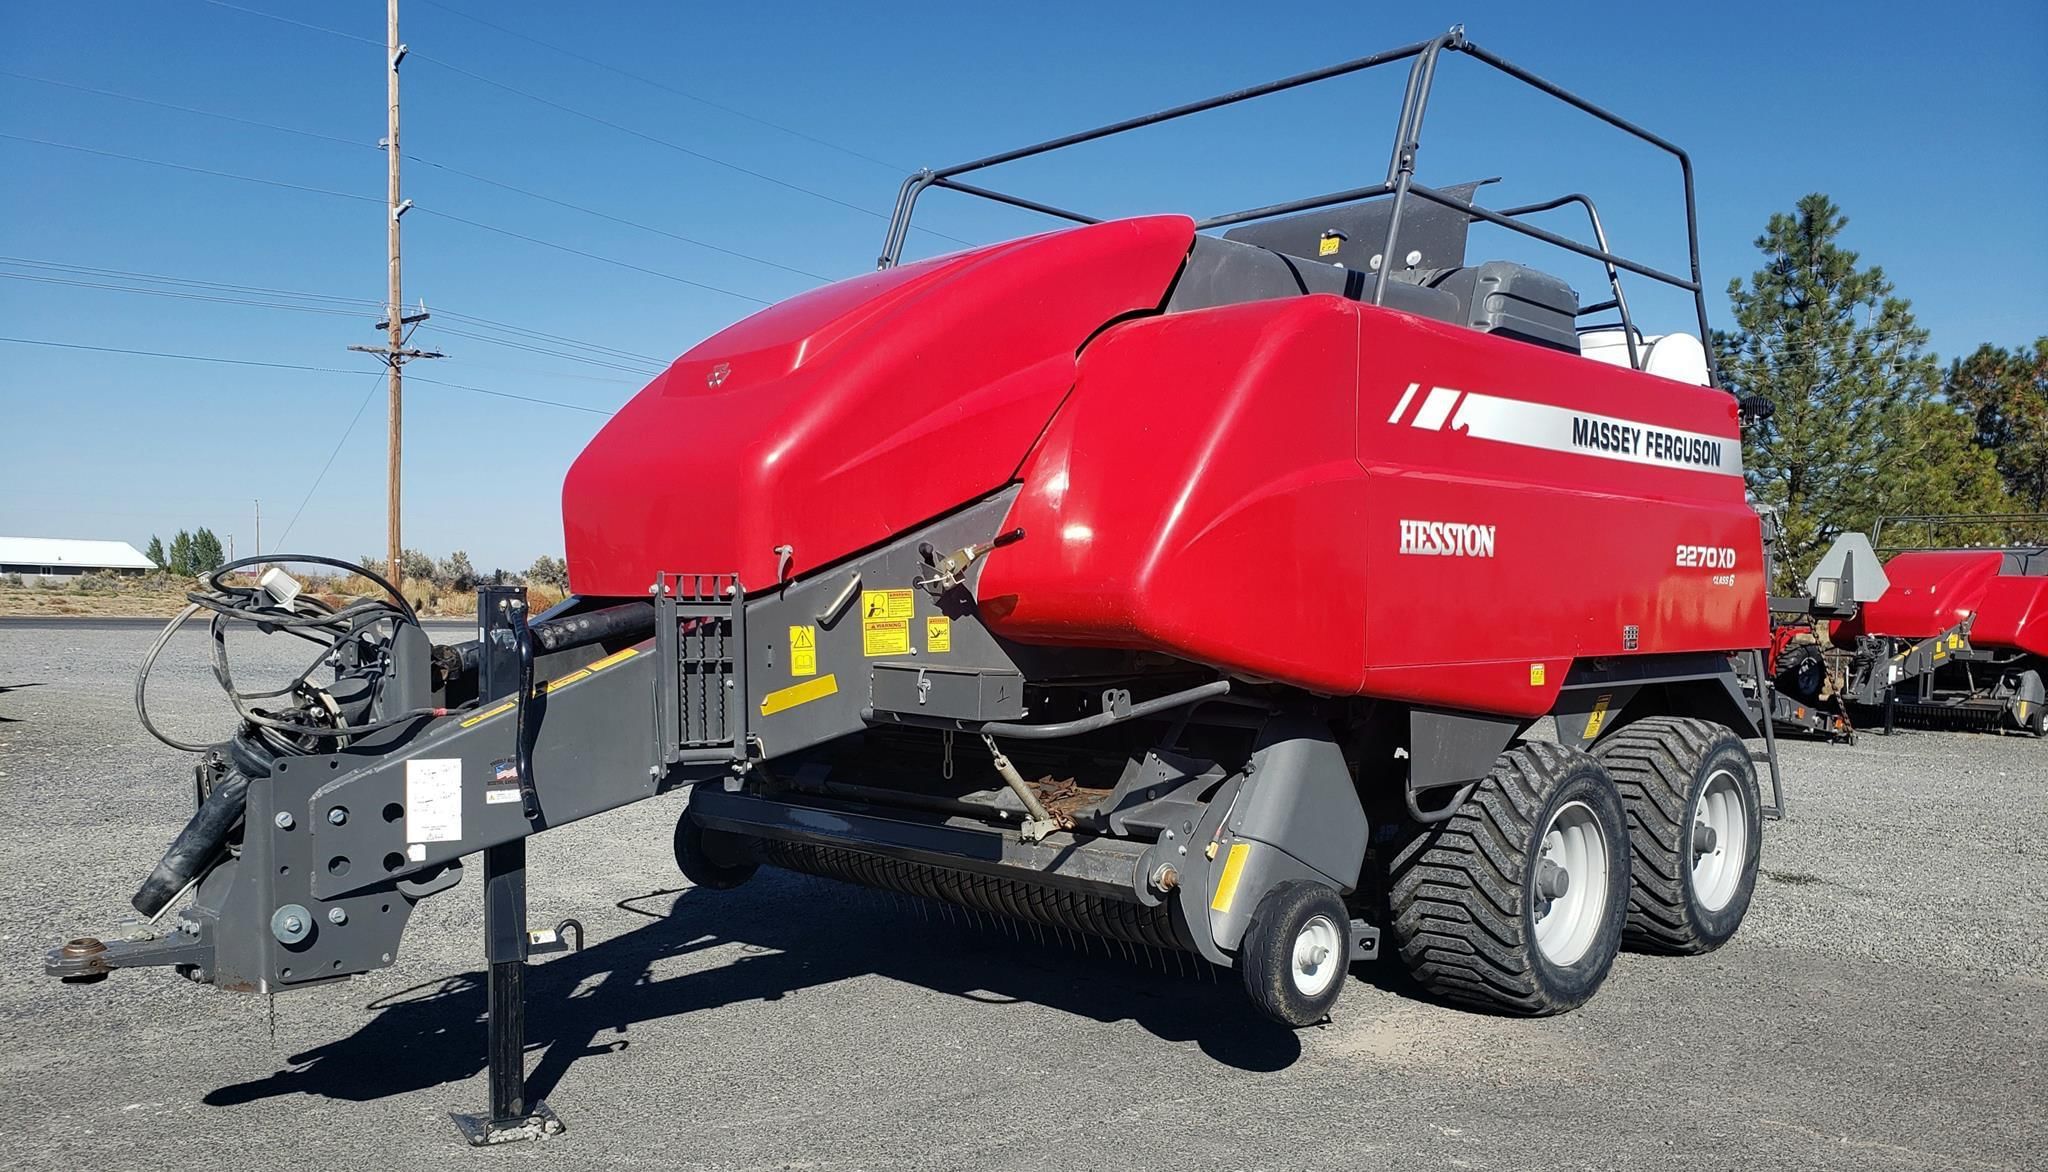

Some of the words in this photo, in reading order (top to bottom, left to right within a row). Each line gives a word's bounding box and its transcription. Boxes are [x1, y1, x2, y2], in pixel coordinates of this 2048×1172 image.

[1572, 416, 1641, 455] MASSEY
[1645, 430, 1721, 466] FERGUSON
[1399, 519, 1496, 558] HESSTON
[1676, 544, 1736, 569] 2270XD
[1712, 575, 1729, 585] CLASS
[1729, 573, 1735, 587] 6
